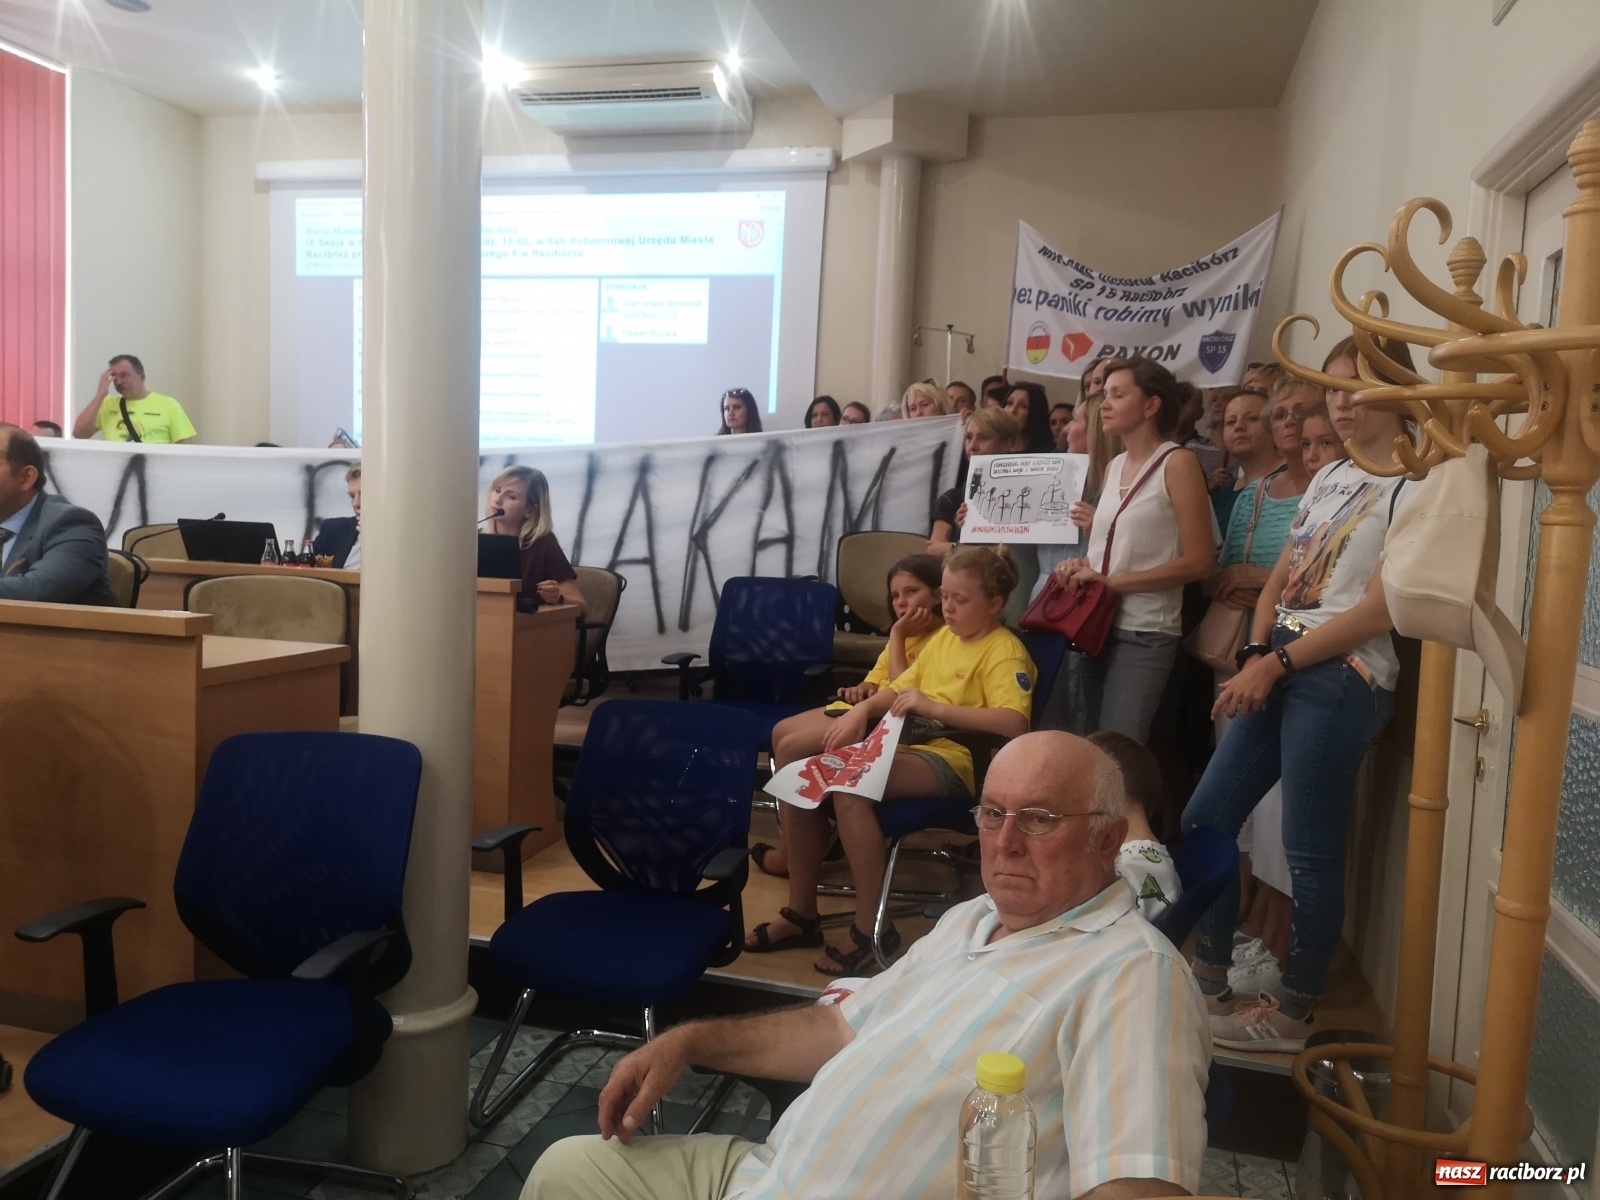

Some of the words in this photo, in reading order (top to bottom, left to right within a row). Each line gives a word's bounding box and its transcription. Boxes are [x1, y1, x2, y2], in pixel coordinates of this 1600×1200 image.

[680, 235, 714, 244] Miasta
[1069, 278, 1096, 291] SP
[1096, 284, 1118, 299] 15
[1035, 289, 1093, 318] paniki
[1094, 305, 1176, 328] robimy
[1182, 281, 1263, 322] wyniki
[1206, 345, 1216, 354] SP
[1217, 345, 1227, 354] 15
